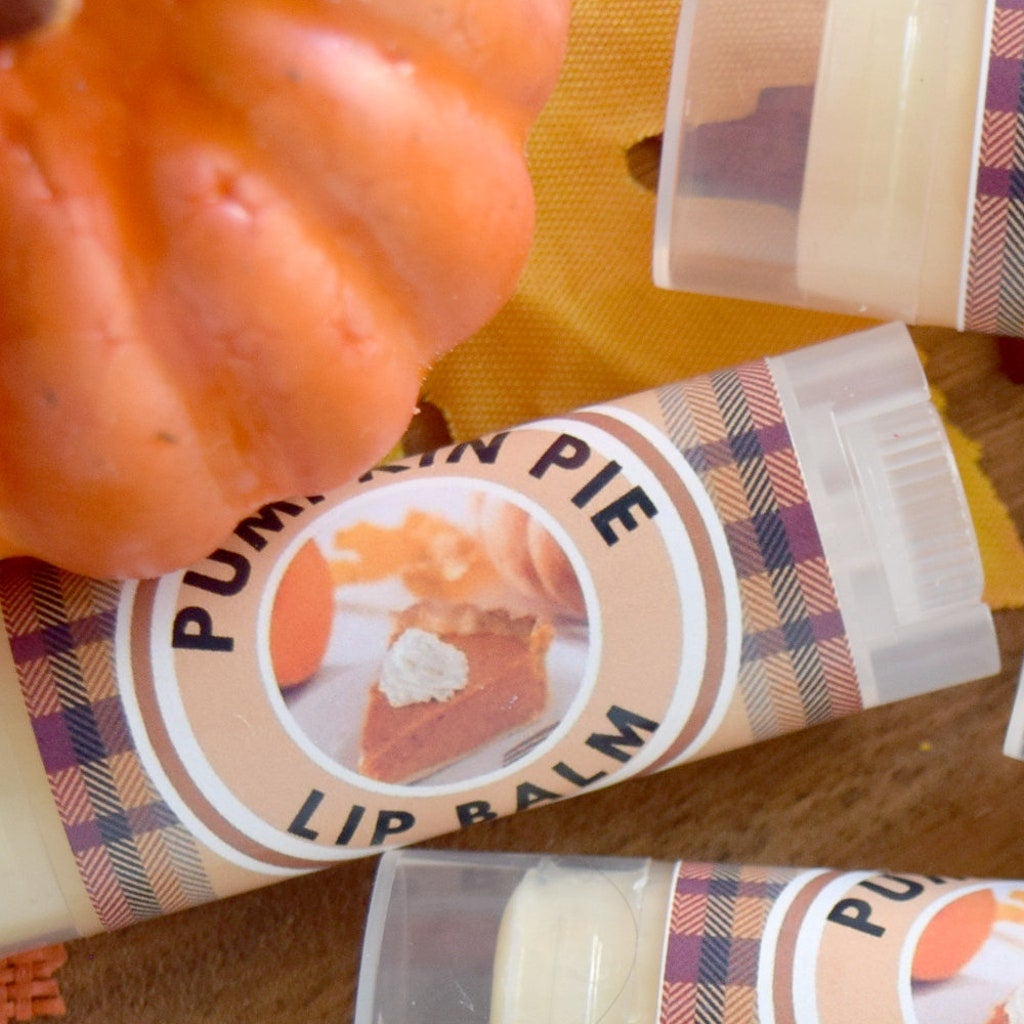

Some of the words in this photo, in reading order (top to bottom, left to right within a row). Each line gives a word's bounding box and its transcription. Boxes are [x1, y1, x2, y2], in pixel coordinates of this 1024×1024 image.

[529, 433, 658, 547] PIE
[287, 789, 416, 847] LIP
[455, 705, 660, 829] BALM
